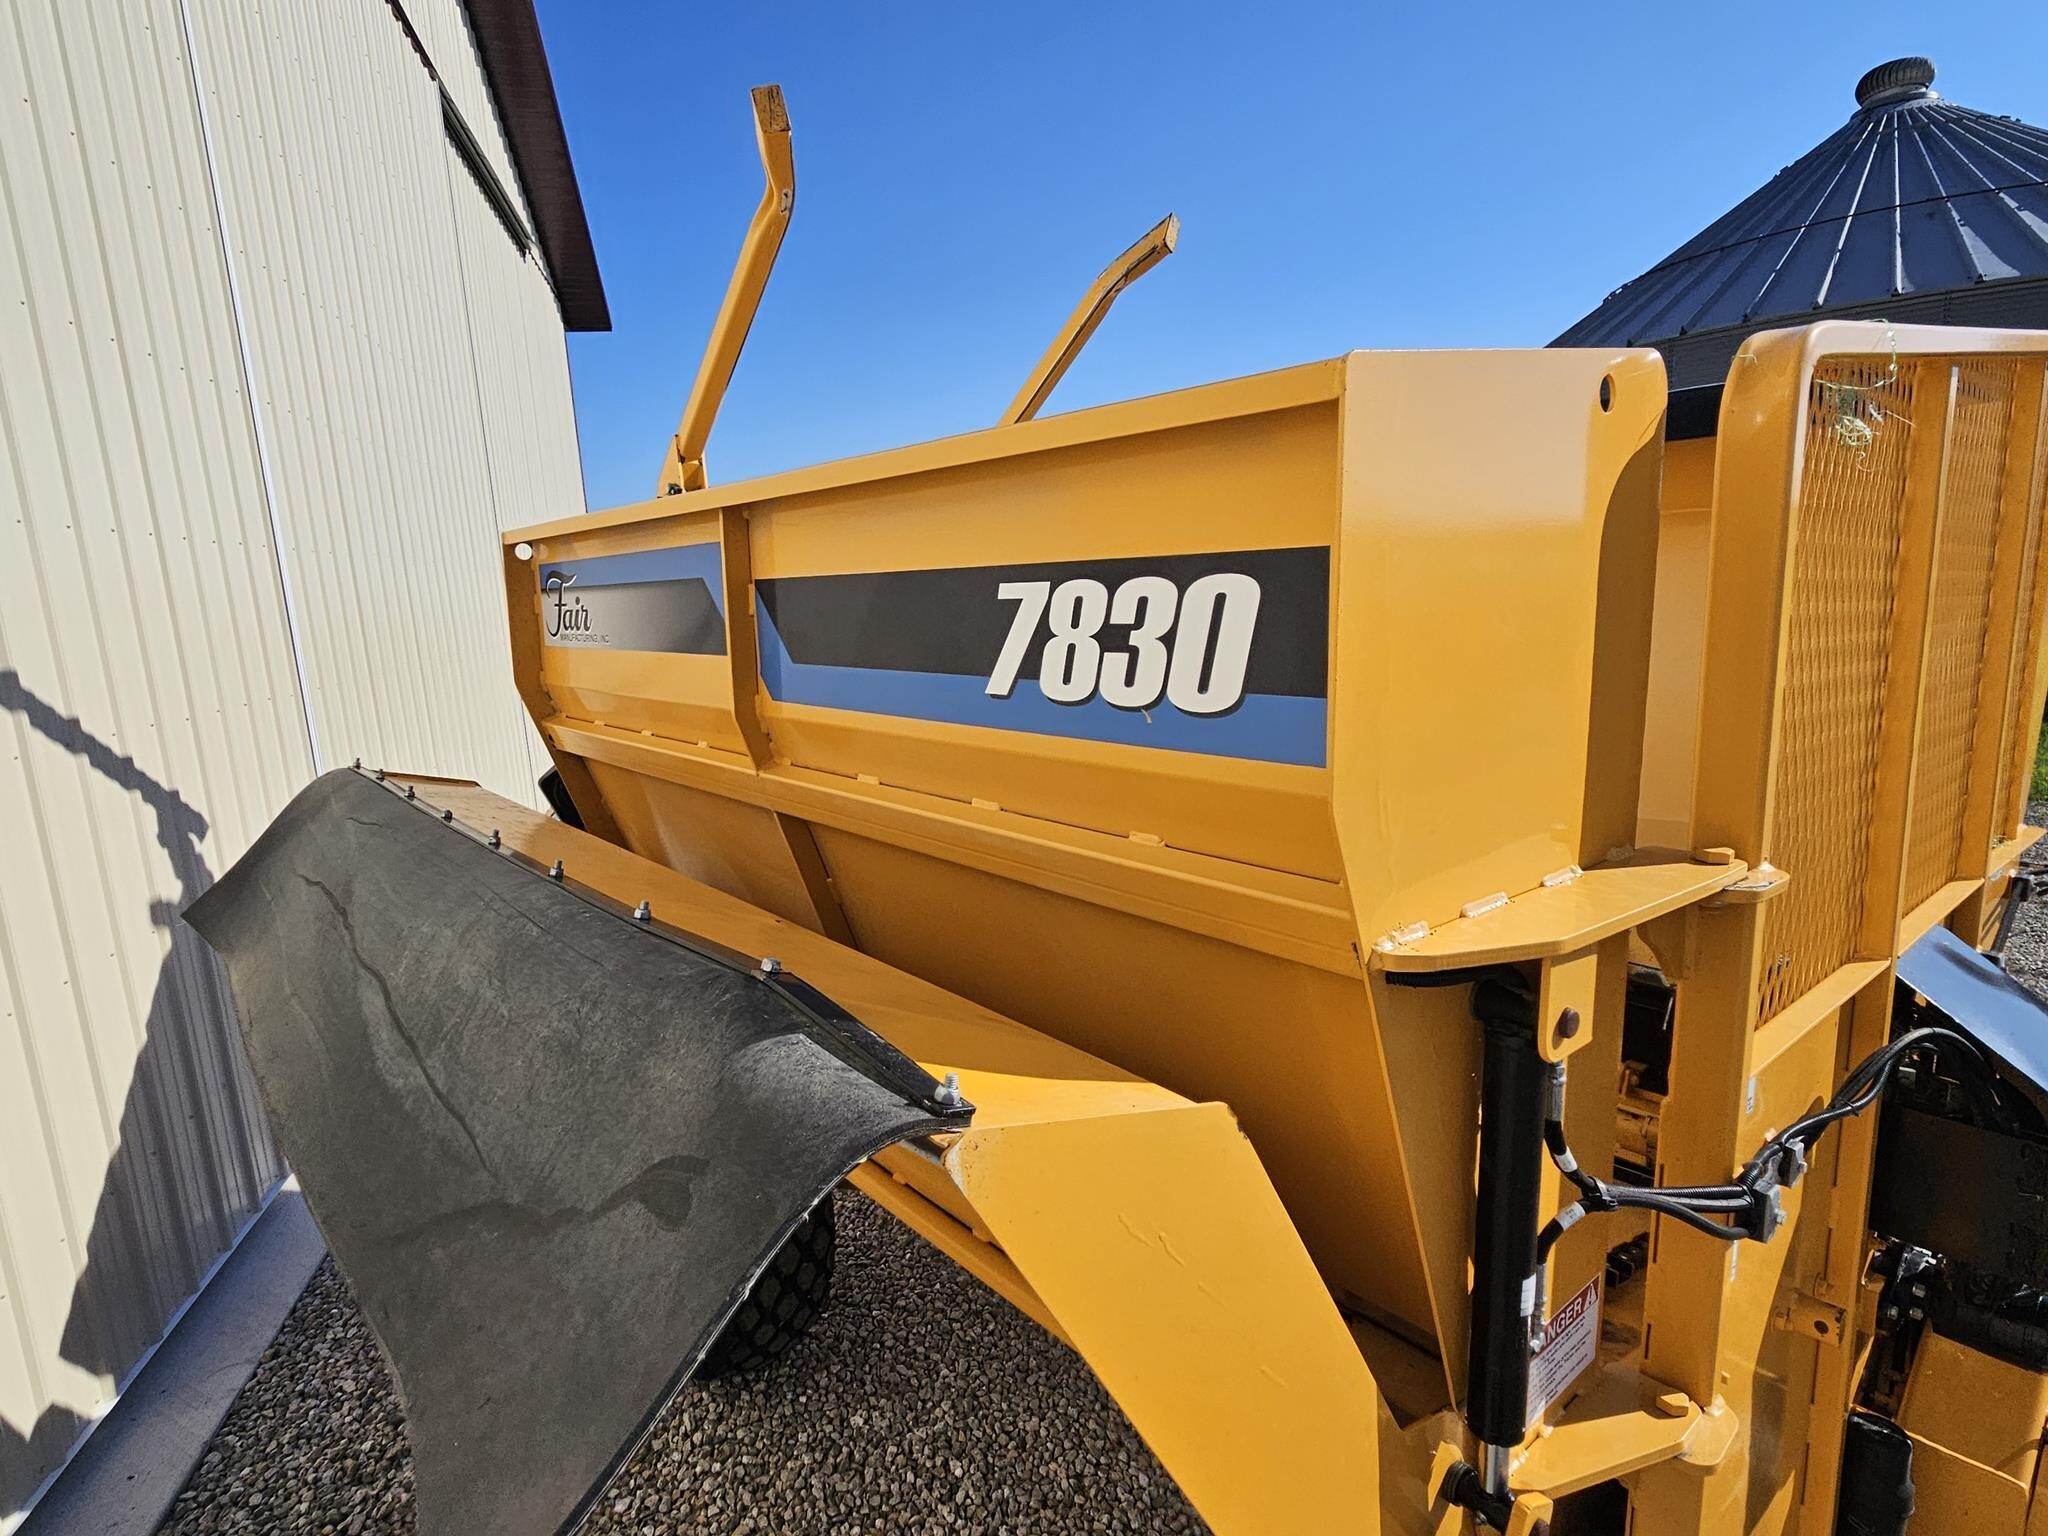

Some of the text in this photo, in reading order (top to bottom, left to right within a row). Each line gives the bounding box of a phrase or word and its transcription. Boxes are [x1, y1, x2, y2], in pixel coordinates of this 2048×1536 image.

[546, 570, 592, 638] Fair
[985, 573, 1261, 717] 7830
[1538, 1297, 1582, 1349] ANGER
